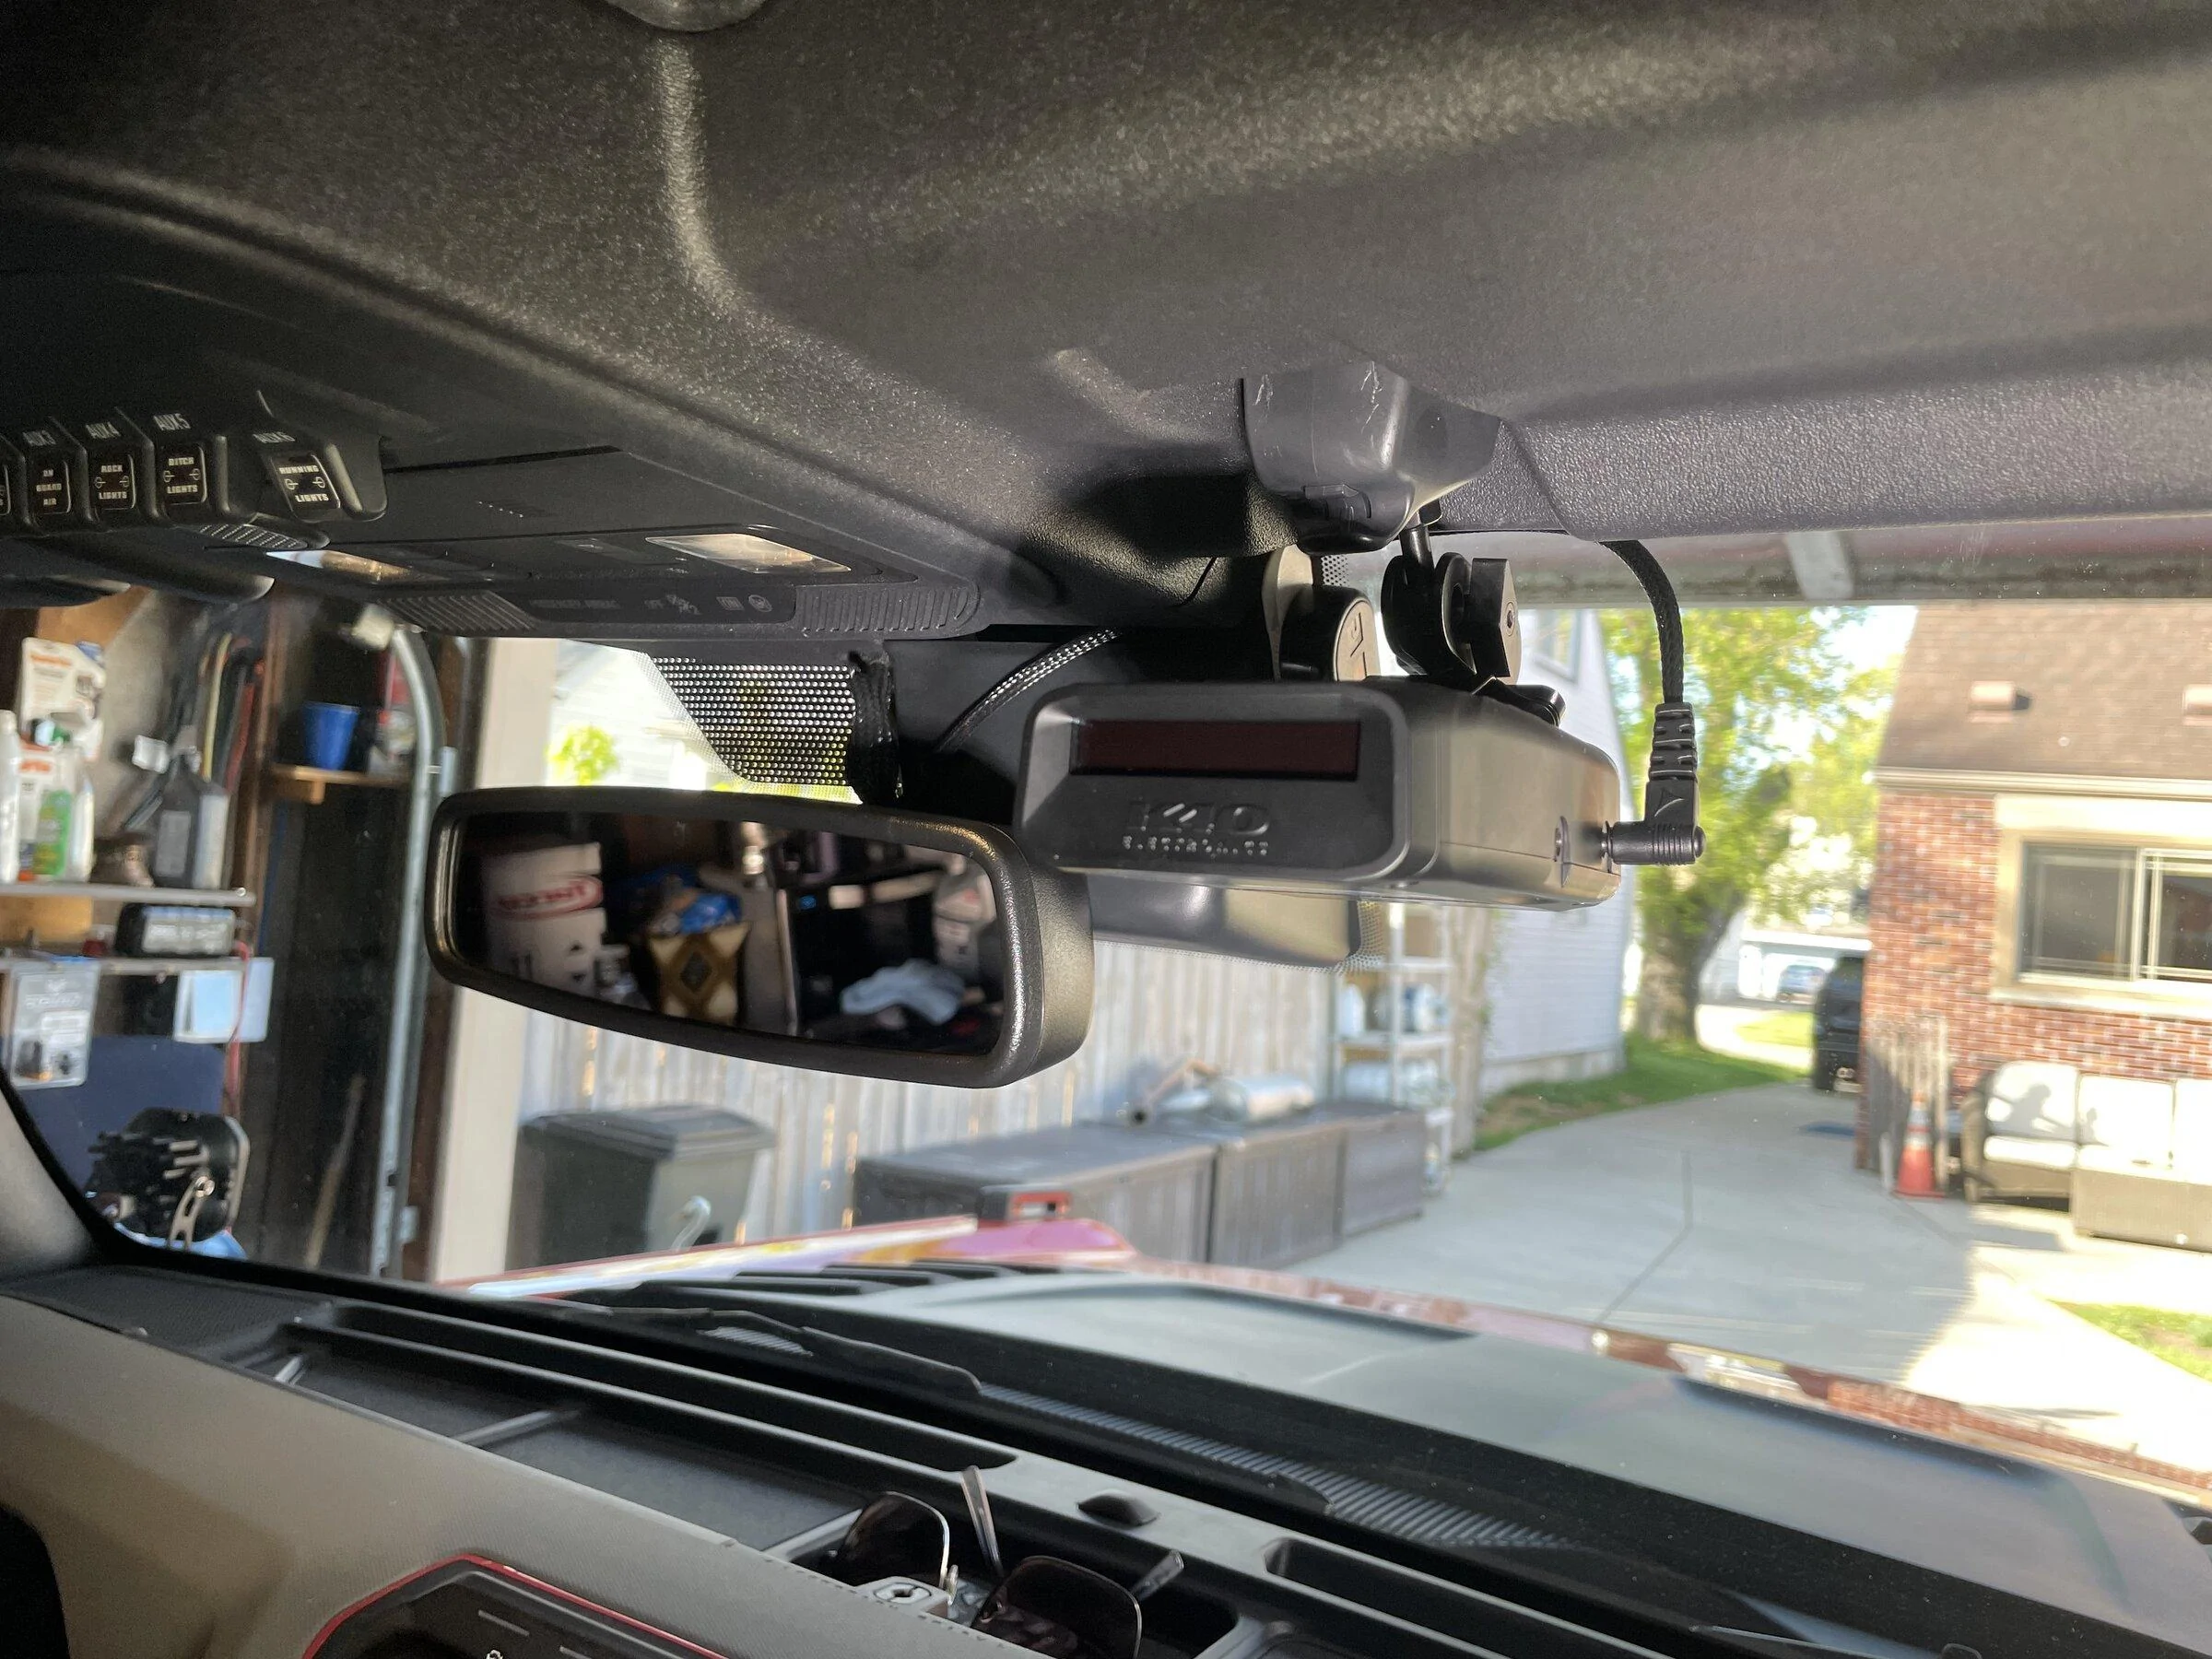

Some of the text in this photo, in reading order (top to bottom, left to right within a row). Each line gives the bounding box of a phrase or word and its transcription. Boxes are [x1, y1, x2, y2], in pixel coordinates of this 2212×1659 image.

[153, 413, 191, 431] AUX5
[86, 421, 122, 439] AUX4
[168, 456, 194, 466] DITCH
[100, 465, 123, 473] ROCK
[278, 465, 319, 475] RUNNING
[166, 484, 198, 494] LIGHTS
[99, 491, 127, 500] LIGHTS
[295, 493, 329, 502] LIGHTS
